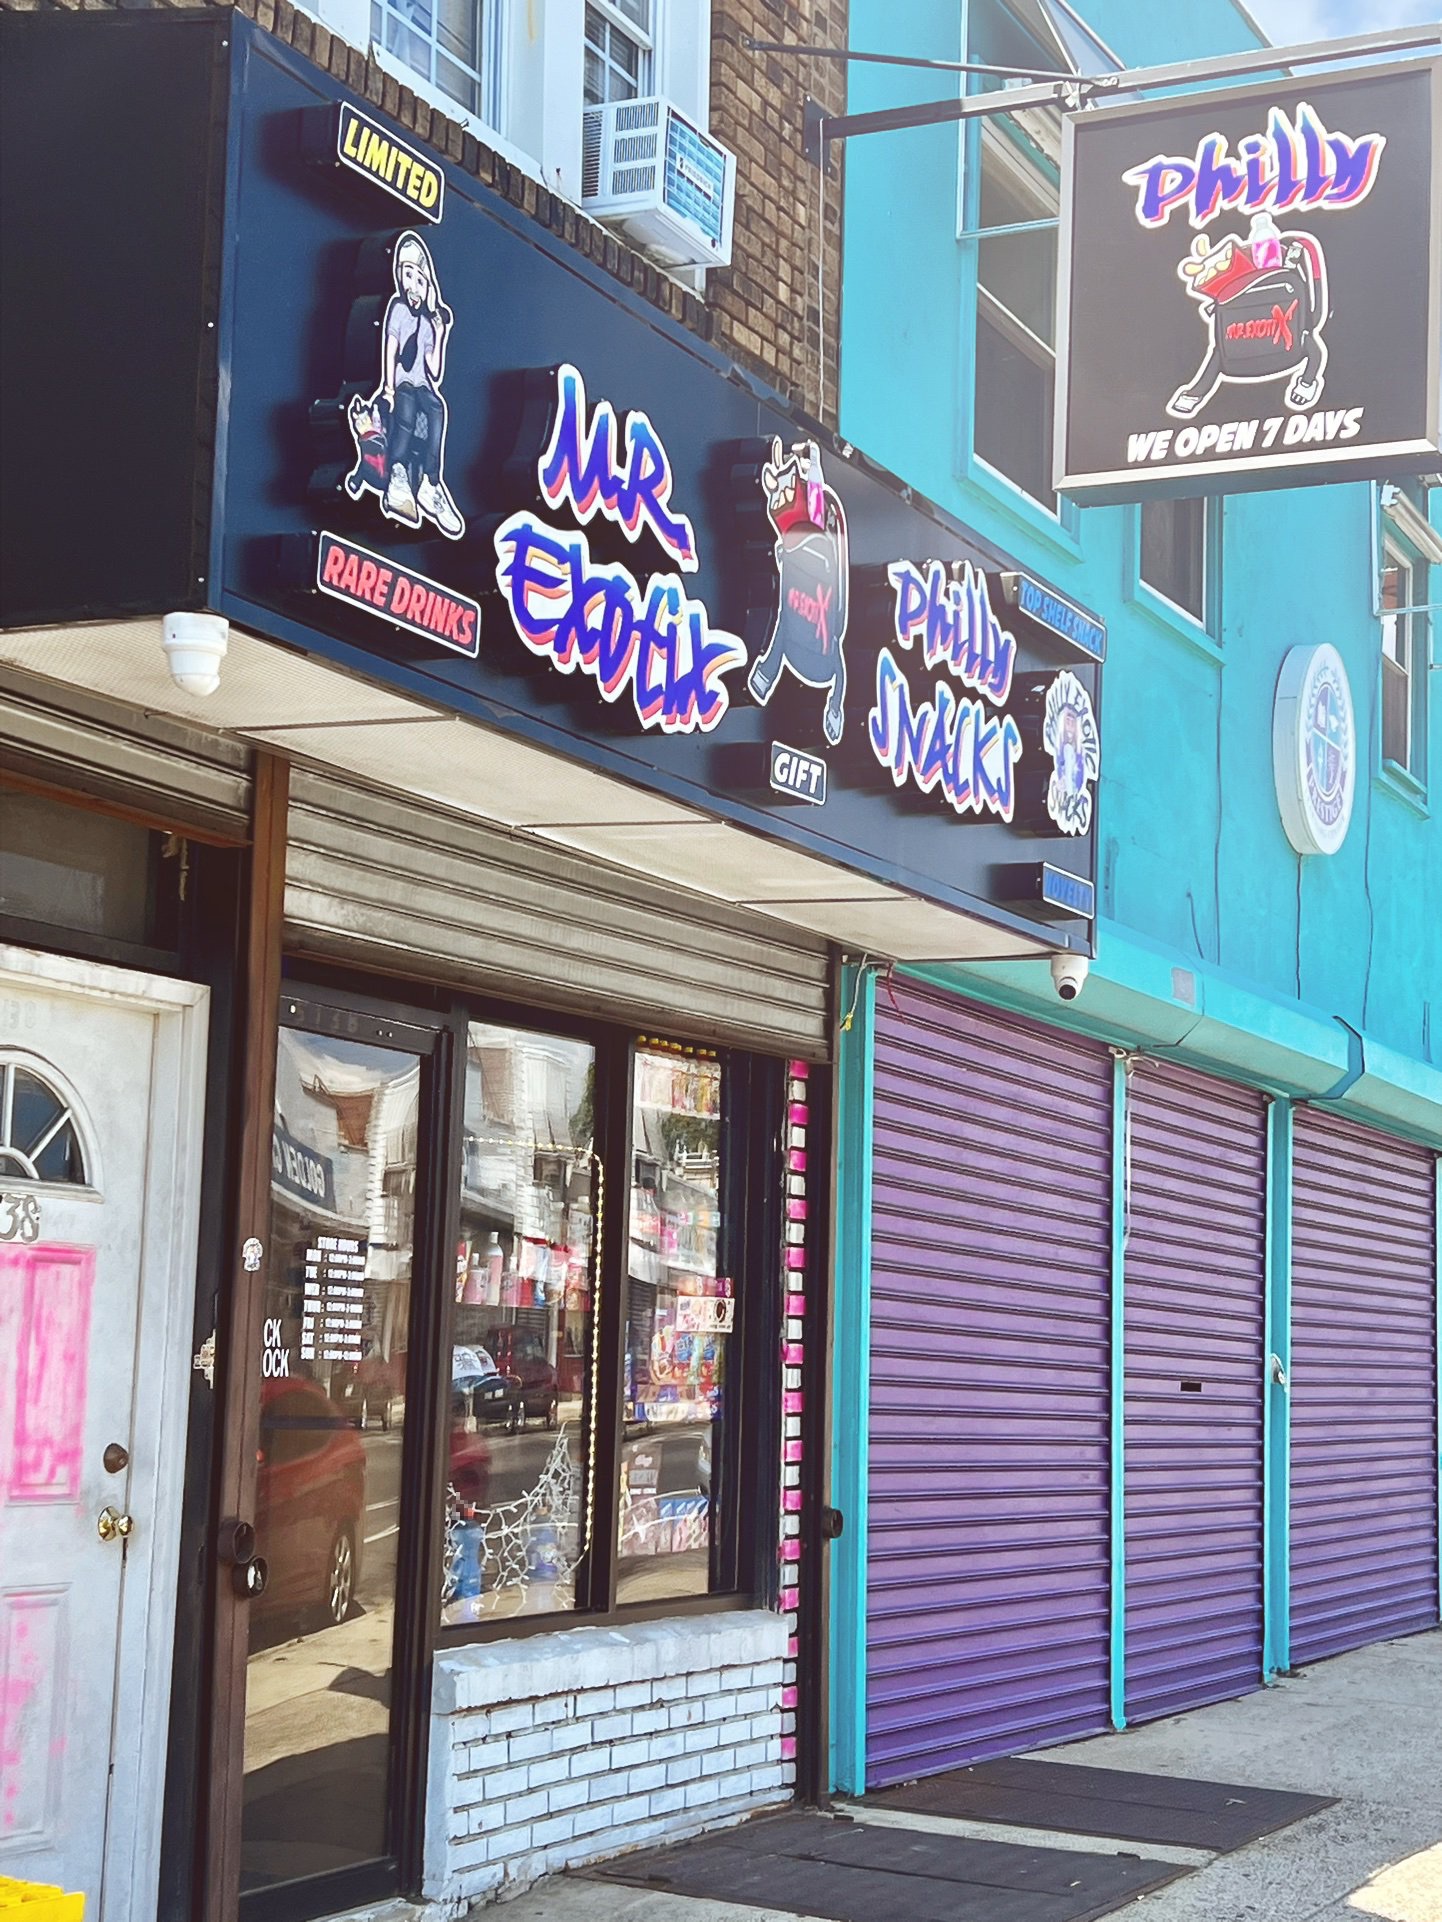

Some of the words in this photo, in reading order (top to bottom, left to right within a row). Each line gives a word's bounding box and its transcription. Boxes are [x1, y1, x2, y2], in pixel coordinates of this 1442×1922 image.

[343, 117, 440, 208] LIMITED
[540, 369, 696, 566] MR
[1126, 428, 1174, 463] WE
[1175, 421, 1258, 457] OPEN
[1261, 416, 1285, 448] 7
[1286, 406, 1365, 444] DAYS
[323, 544, 393, 606] RARE
[391, 577, 475, 645] DRINKS
[1020, 580, 1042, 613] TOP
[1041, 596, 1073, 633] SHELF
[773, 751, 822, 793] GIFT
